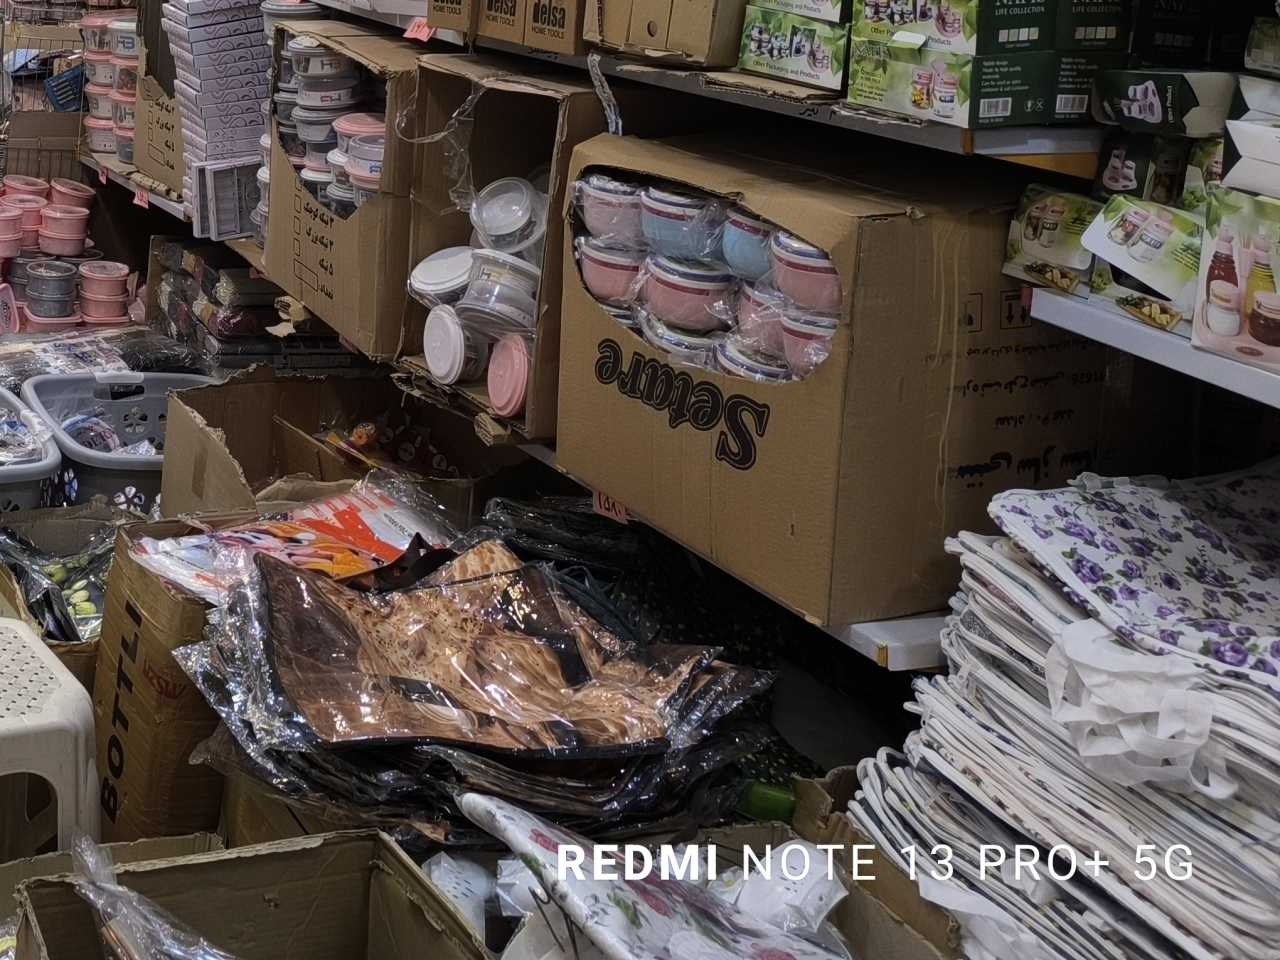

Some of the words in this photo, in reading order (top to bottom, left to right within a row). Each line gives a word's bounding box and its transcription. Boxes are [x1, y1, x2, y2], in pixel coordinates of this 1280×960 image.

[433, 5, 446, 14] HOME
[446, 6, 461, 15] TOOLS
[794, 2, 803, 10] and
[803, 3, 822, 14] Products
[1009, 6, 1045, 14] COLLECTION
[486, 15, 500, 24] HOME
[500, 17, 515, 27] TOOLS
[532, 25, 547, 36] HOME
[547, 27, 564, 40] TOOLS
[870, 26, 886, 35] Other
[927, 35, 952, 46] Products
[753, 59, 766, 67] Other
[766, 61, 789, 76] Packaging
[789, 67, 800, 76] and
[800, 70, 820, 80] Products
[861, 67, 866, 75] 6
[595, 338, 770, 471] Setare
